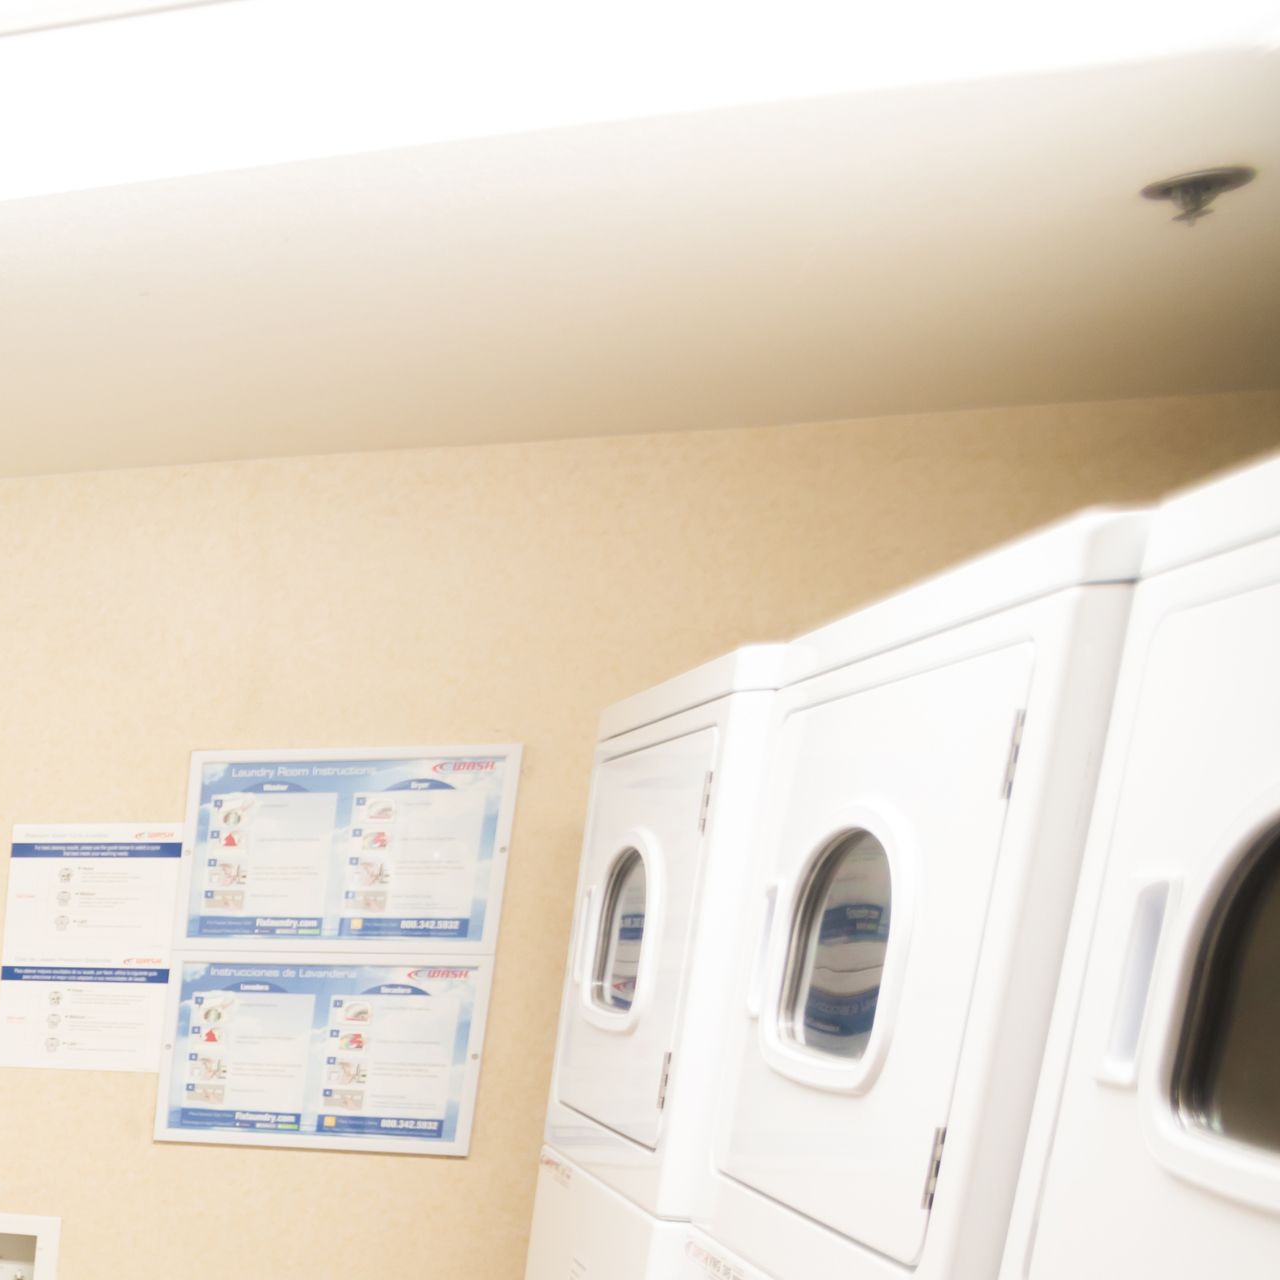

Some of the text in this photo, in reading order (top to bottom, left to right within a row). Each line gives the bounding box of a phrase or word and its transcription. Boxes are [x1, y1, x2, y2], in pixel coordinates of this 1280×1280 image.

[452, 761, 496, 771] WASH
[232, 767, 273, 778] Laundry
[277, 767, 309, 777] Room
